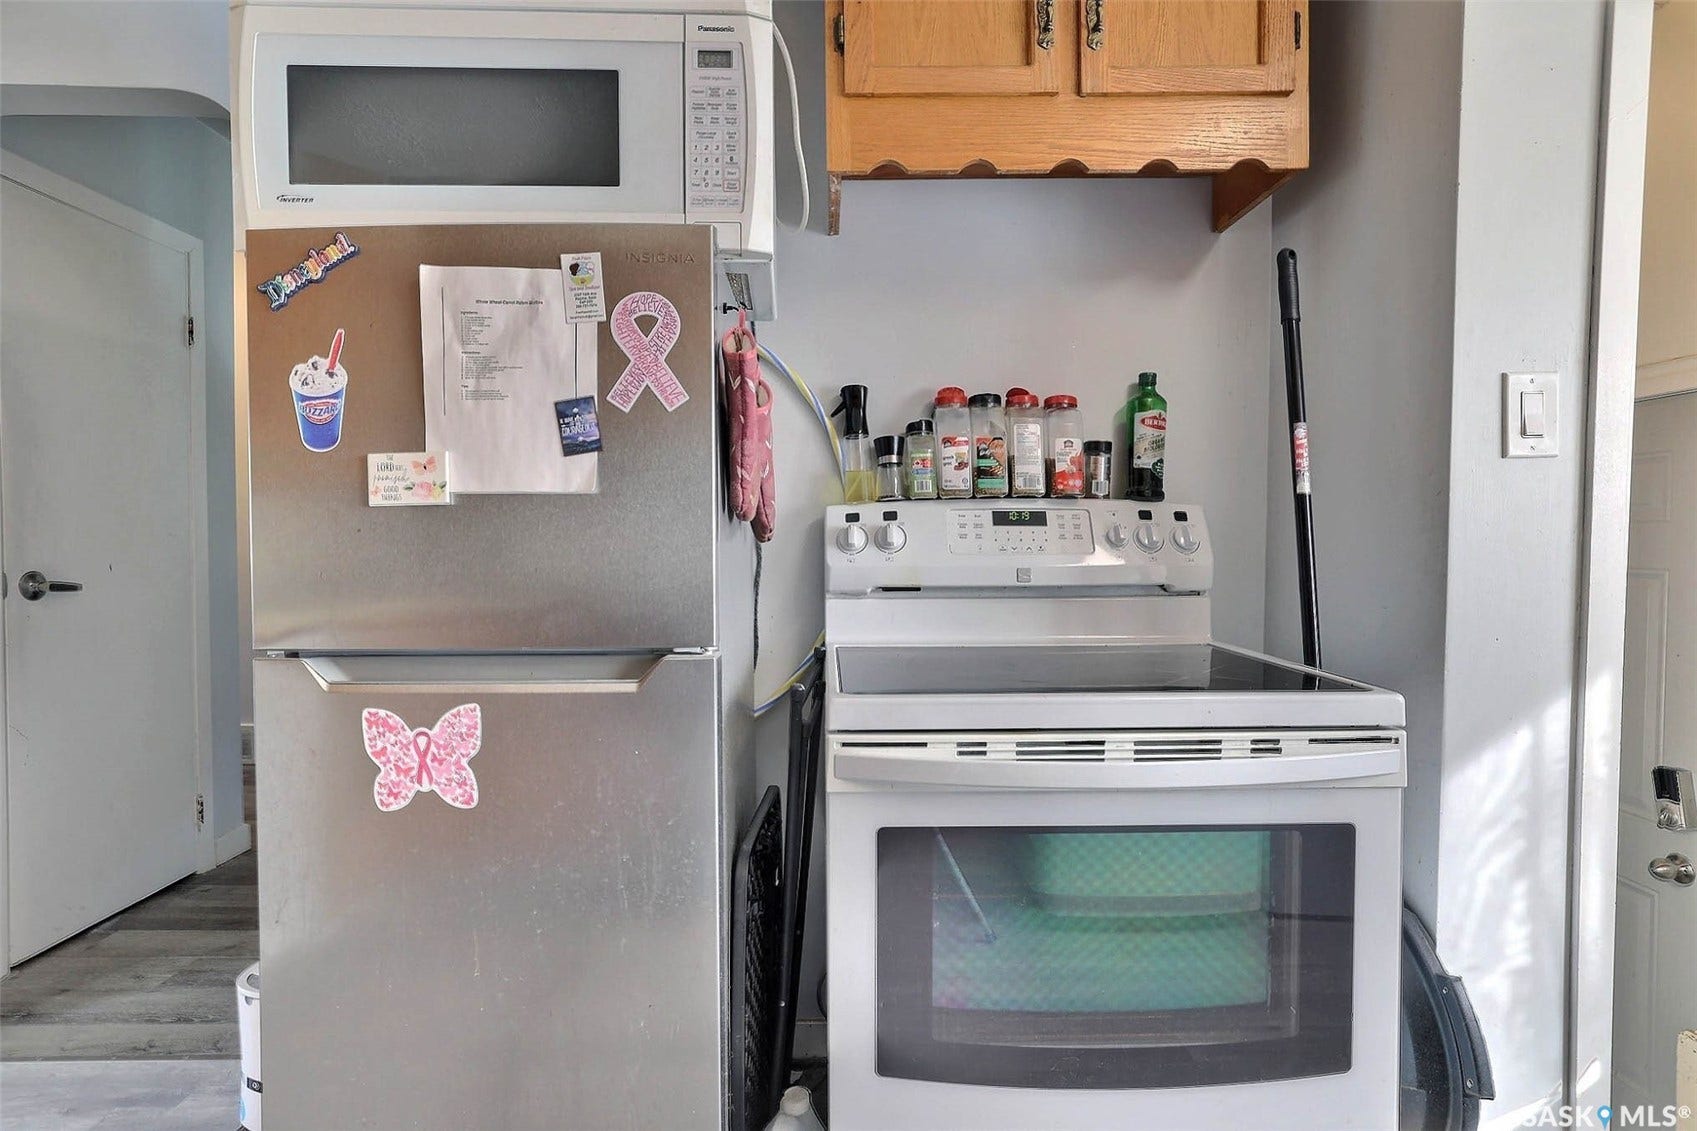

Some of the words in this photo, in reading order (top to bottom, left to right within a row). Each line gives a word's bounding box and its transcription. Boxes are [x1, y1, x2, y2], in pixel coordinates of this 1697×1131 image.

[277, 195, 314, 203] INVERTER
[625, 252, 695, 264] INSIGNIA
[256, 231, 357, 311] Disneyland
[634, 293, 658, 305] HOPE
[628, 300, 664, 318] BELIEVE
[655, 361, 685, 403] BELIEVE
[1009, 511, 1030, 521] 10:19
